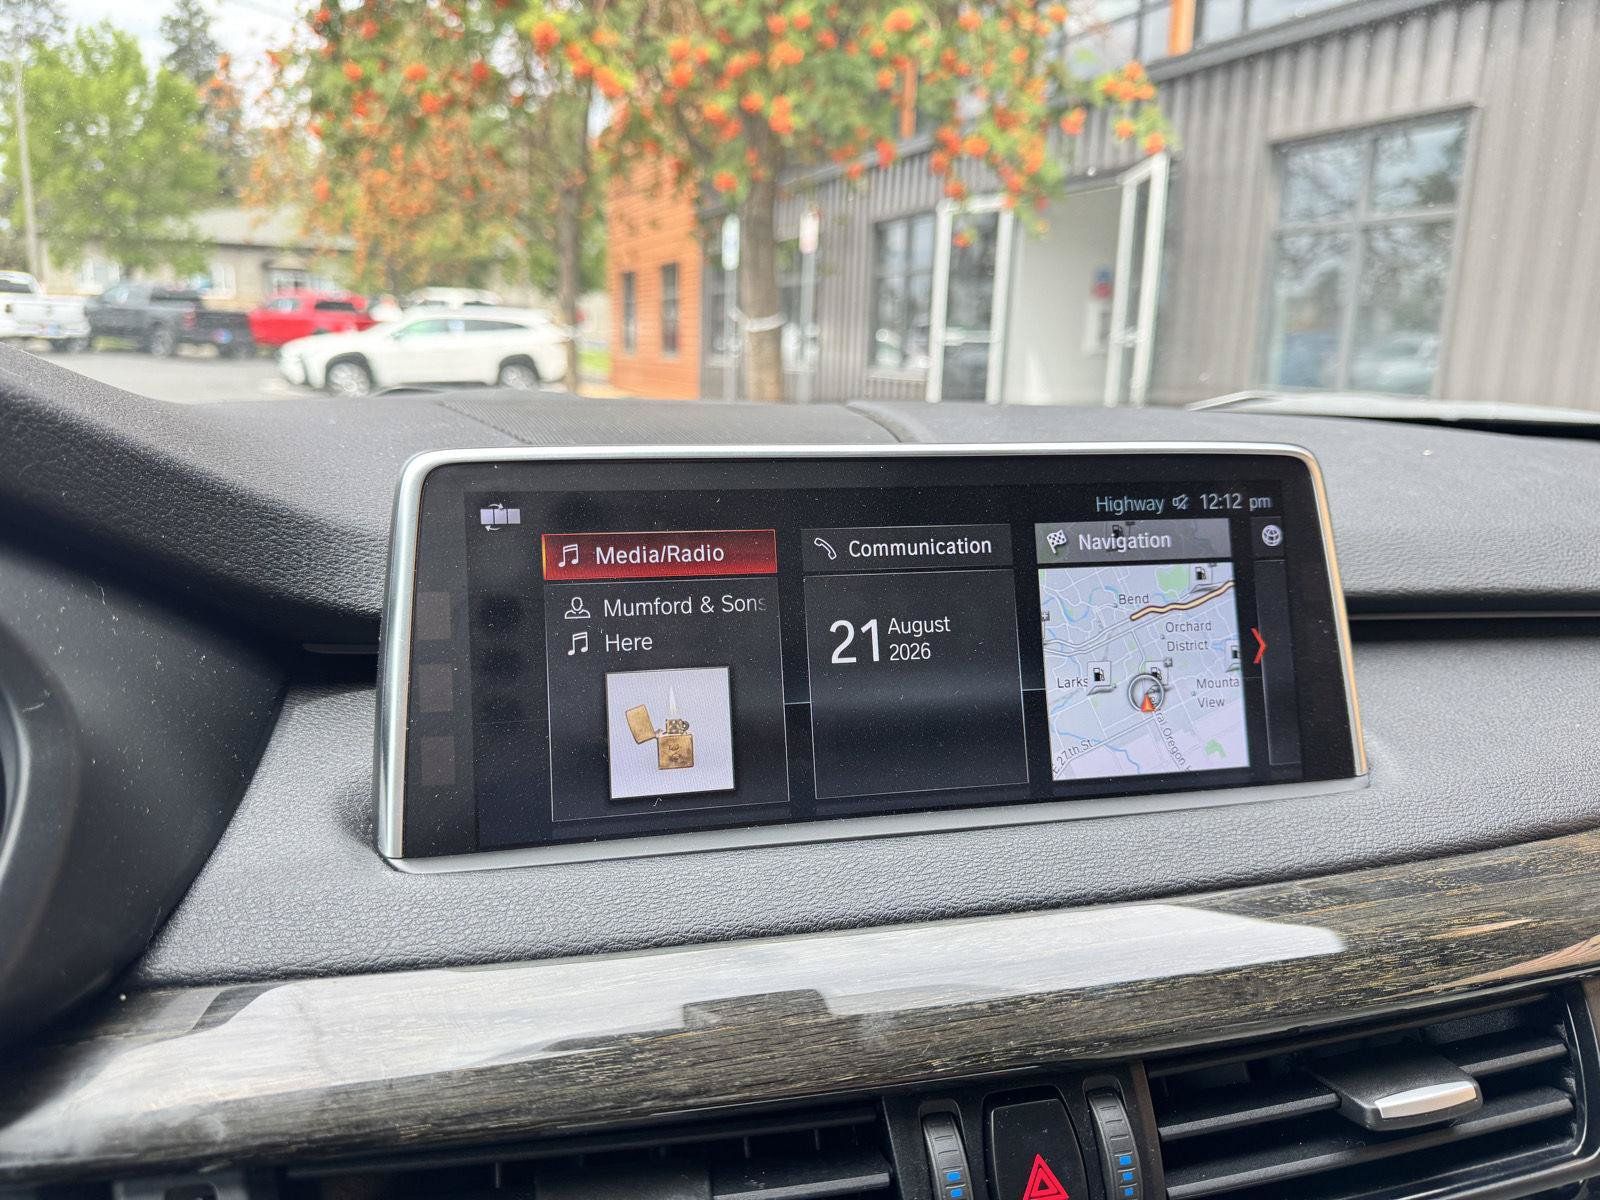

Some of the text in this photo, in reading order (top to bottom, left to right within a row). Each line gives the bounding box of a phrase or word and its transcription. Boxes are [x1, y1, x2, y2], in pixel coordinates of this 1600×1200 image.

[1096, 496, 1164, 515] Highway
[1200, 493, 1272, 512] 12:12 pm
[848, 537, 992, 557] Communication
[1079, 532, 1171, 552] Navigation
[595, 544, 725, 565] Media/Radio
[603, 594, 767, 617] Mumford & Sons
[1118, 593, 1149, 605] Bend
[887, 616, 951, 637] August
[1165, 621, 1212, 632] Orchard
[605, 634, 653, 652] Here
[829, 618, 880, 664] 21
[1167, 640, 1209, 652] District
[889, 642, 931, 661] 2026
[1196, 677, 1240, 689] Mounta
[1197, 697, 1225, 708] View
[1163, 727, 1186, 766] Oregon
